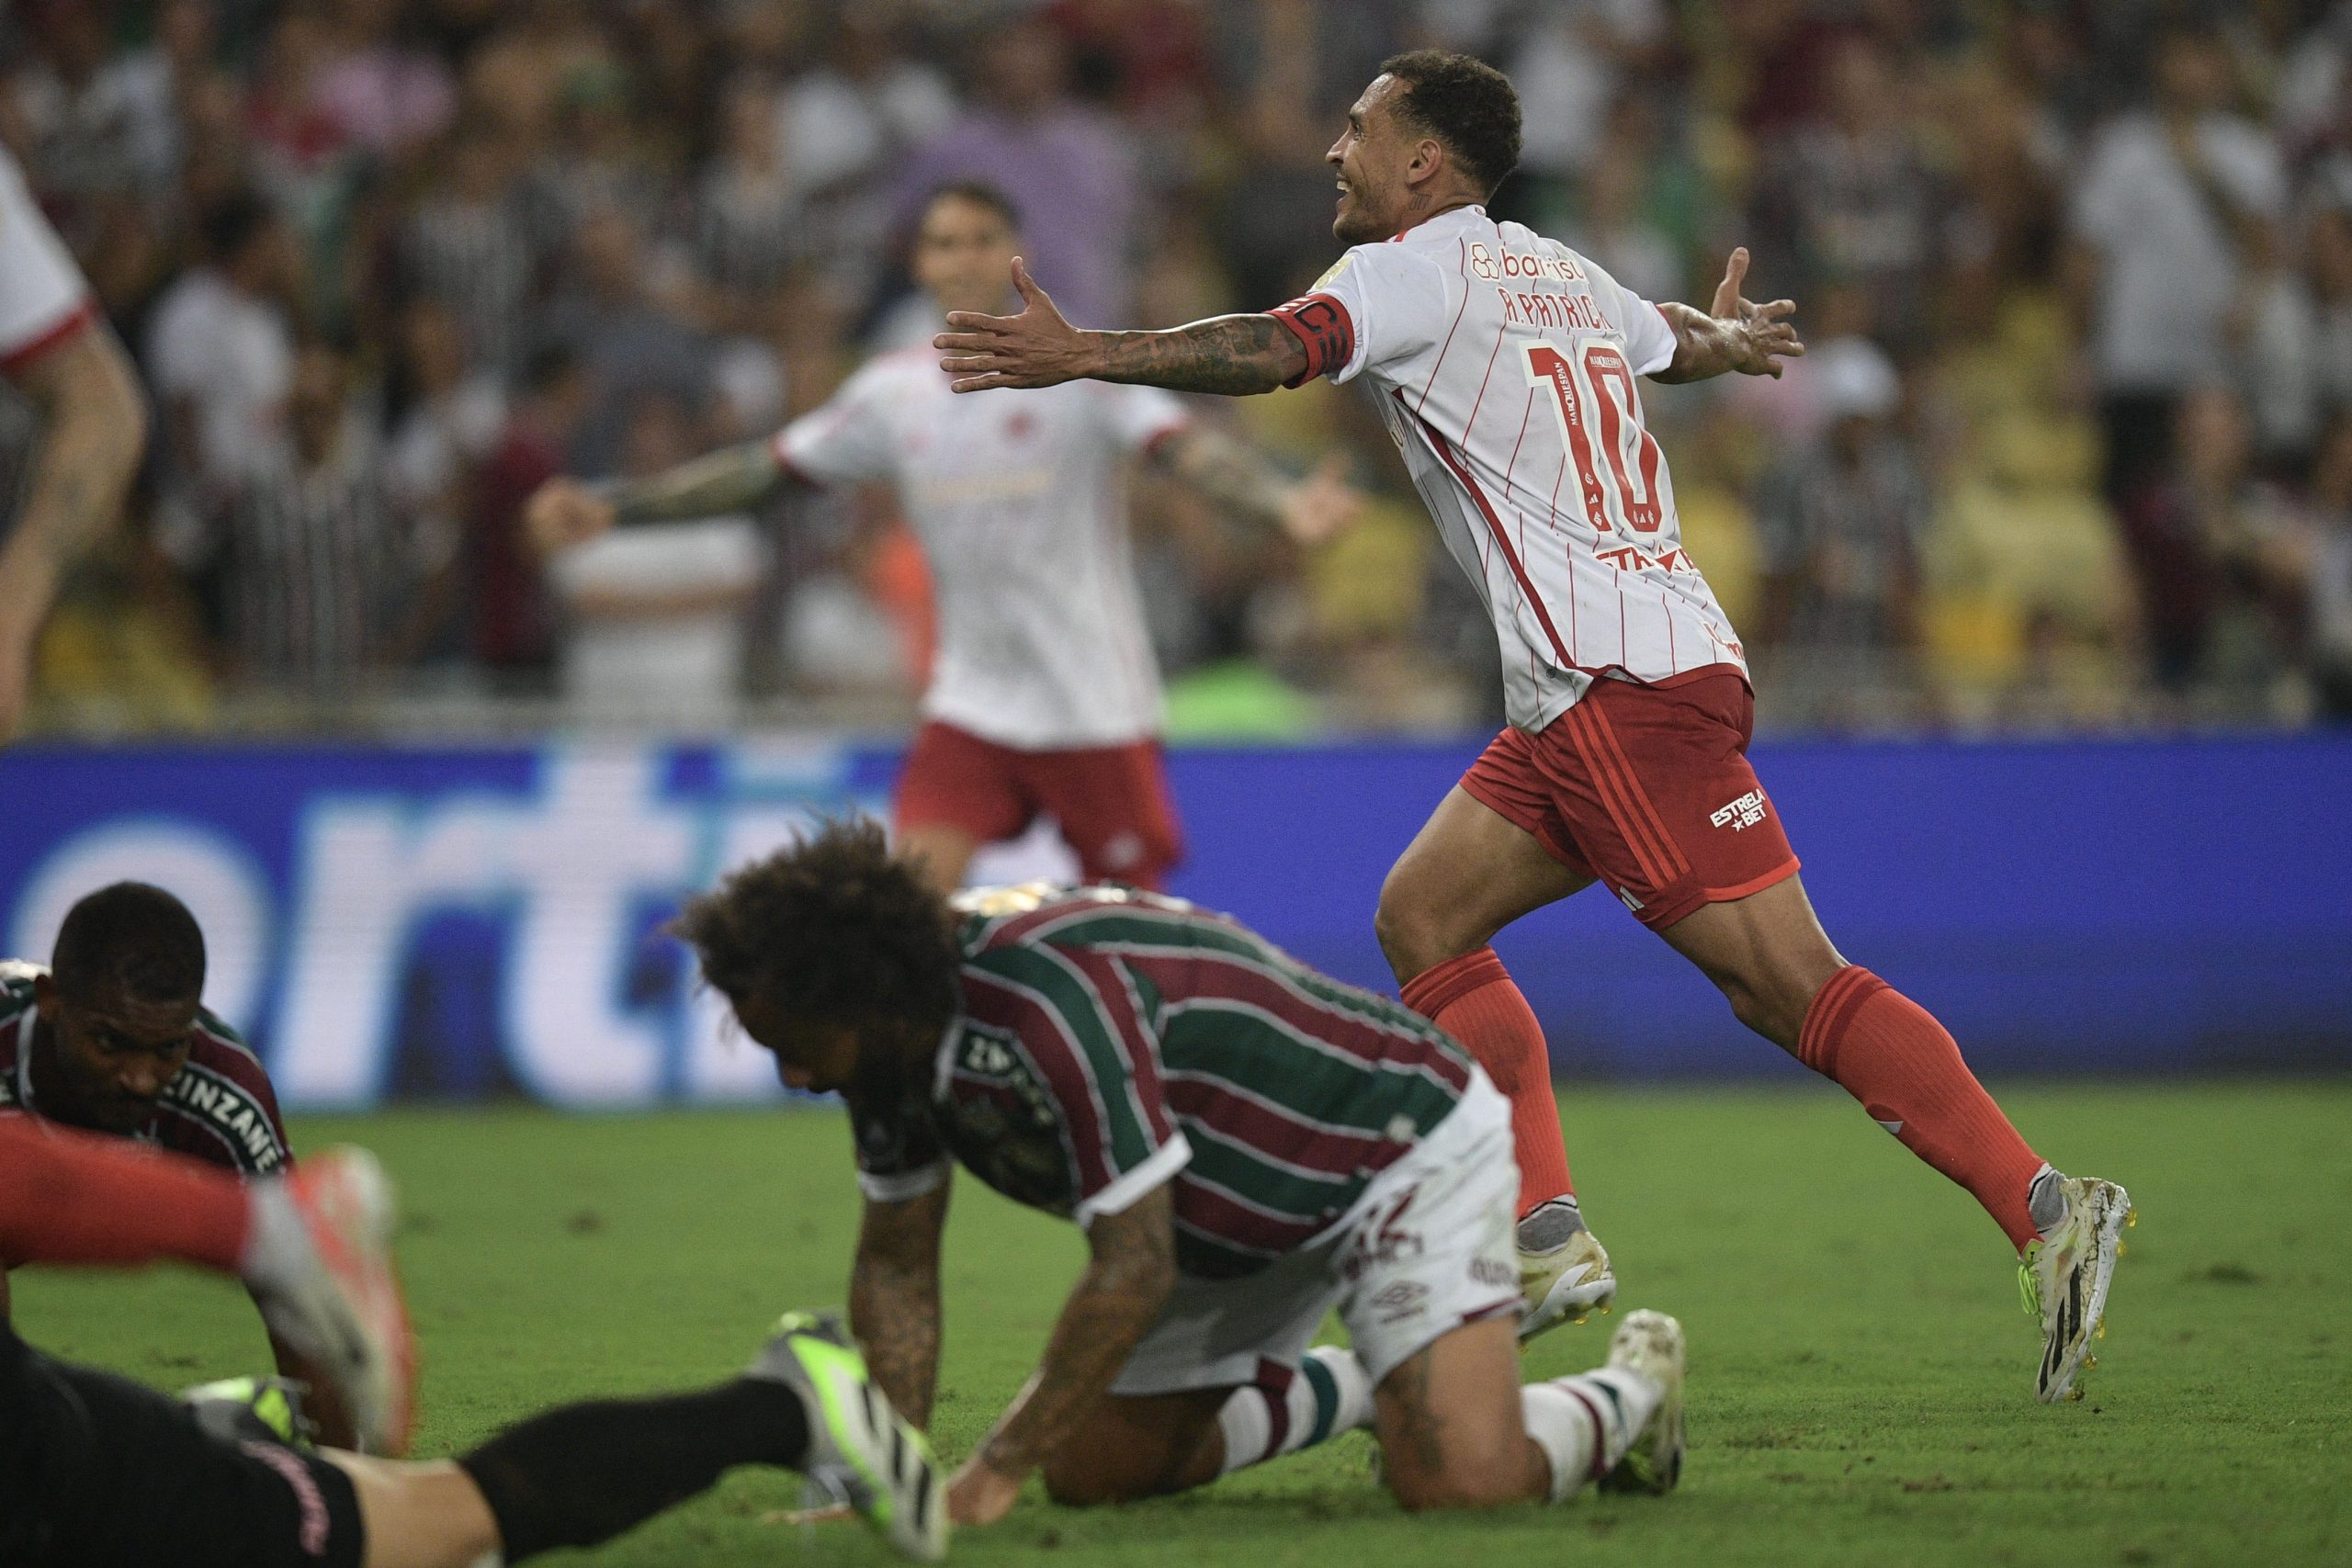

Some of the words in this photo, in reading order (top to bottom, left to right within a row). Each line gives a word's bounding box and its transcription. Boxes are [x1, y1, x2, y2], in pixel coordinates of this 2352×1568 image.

[1524, 344, 1663, 535] 10
[1710, 788, 1766, 828] ESTRELA
[1740, 804, 1767, 827] BET
